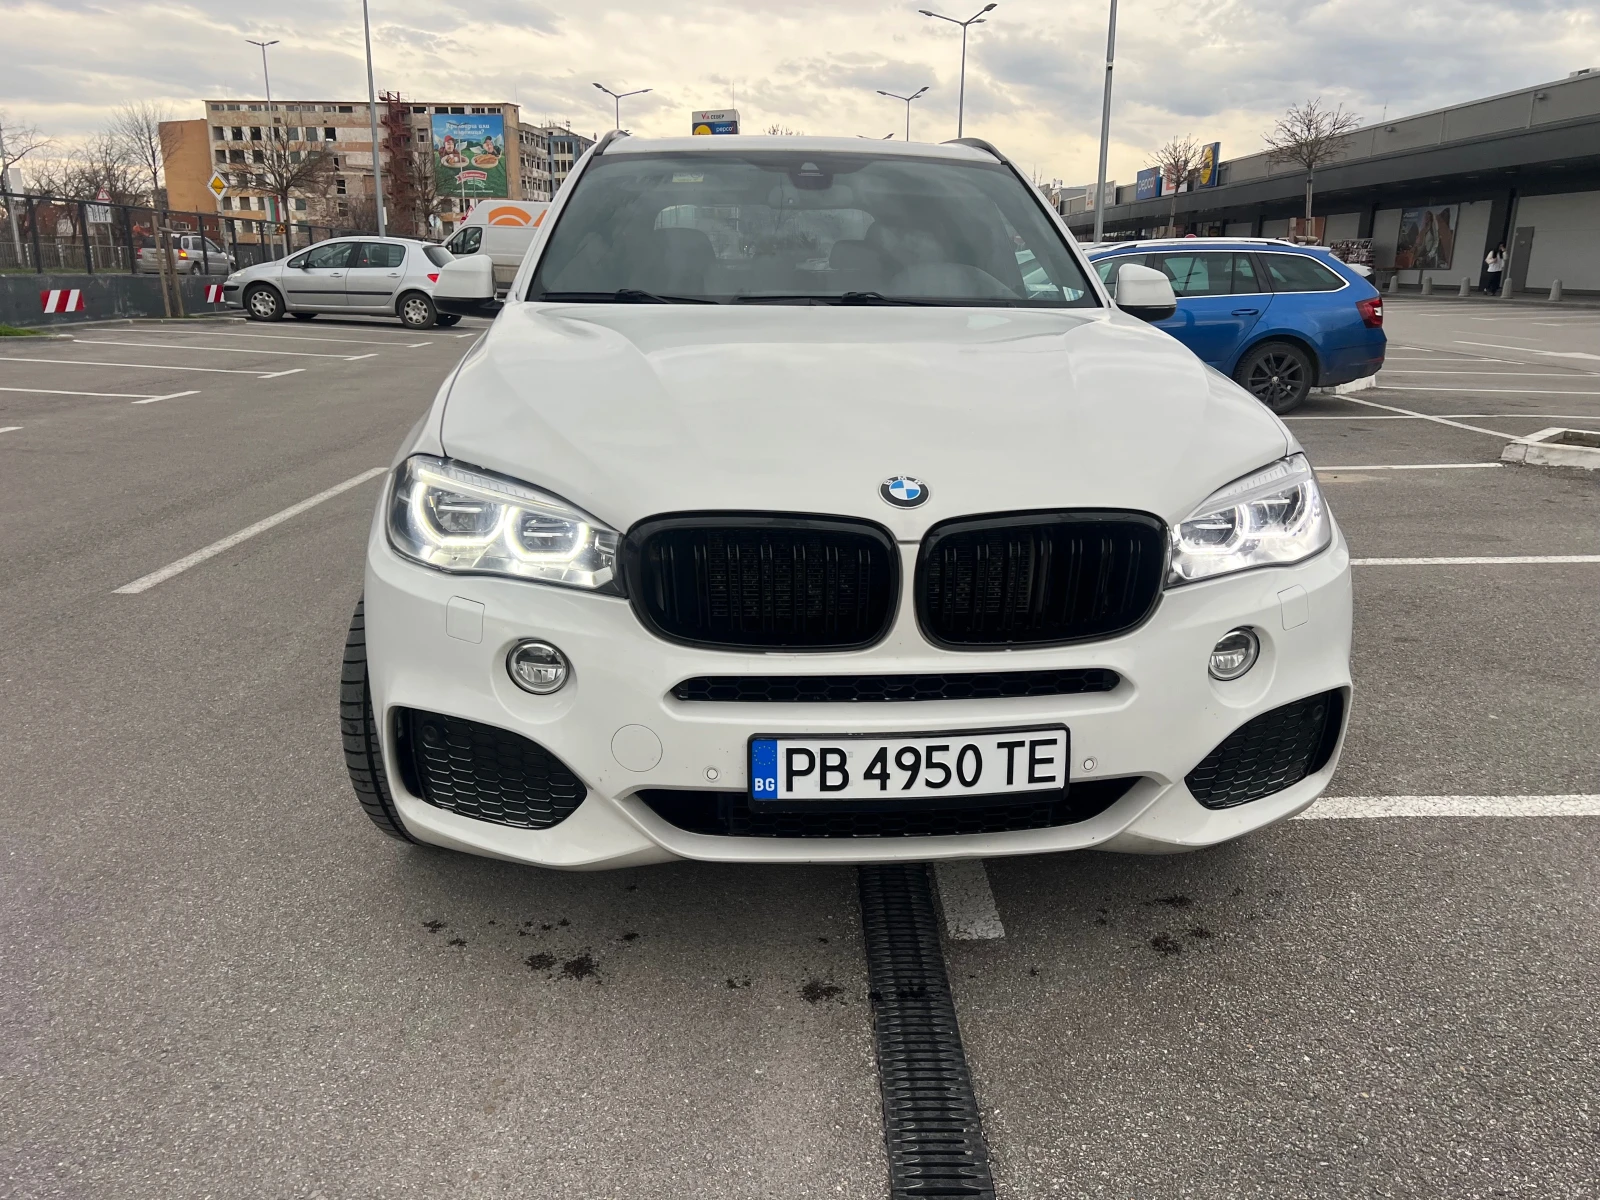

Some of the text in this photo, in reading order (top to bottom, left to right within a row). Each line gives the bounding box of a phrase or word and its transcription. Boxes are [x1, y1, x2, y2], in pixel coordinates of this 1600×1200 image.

[1138, 176, 1155, 193] pepco
[786, 738, 1058, 792] PB 4950 TE
[754, 777, 775, 790] BG
